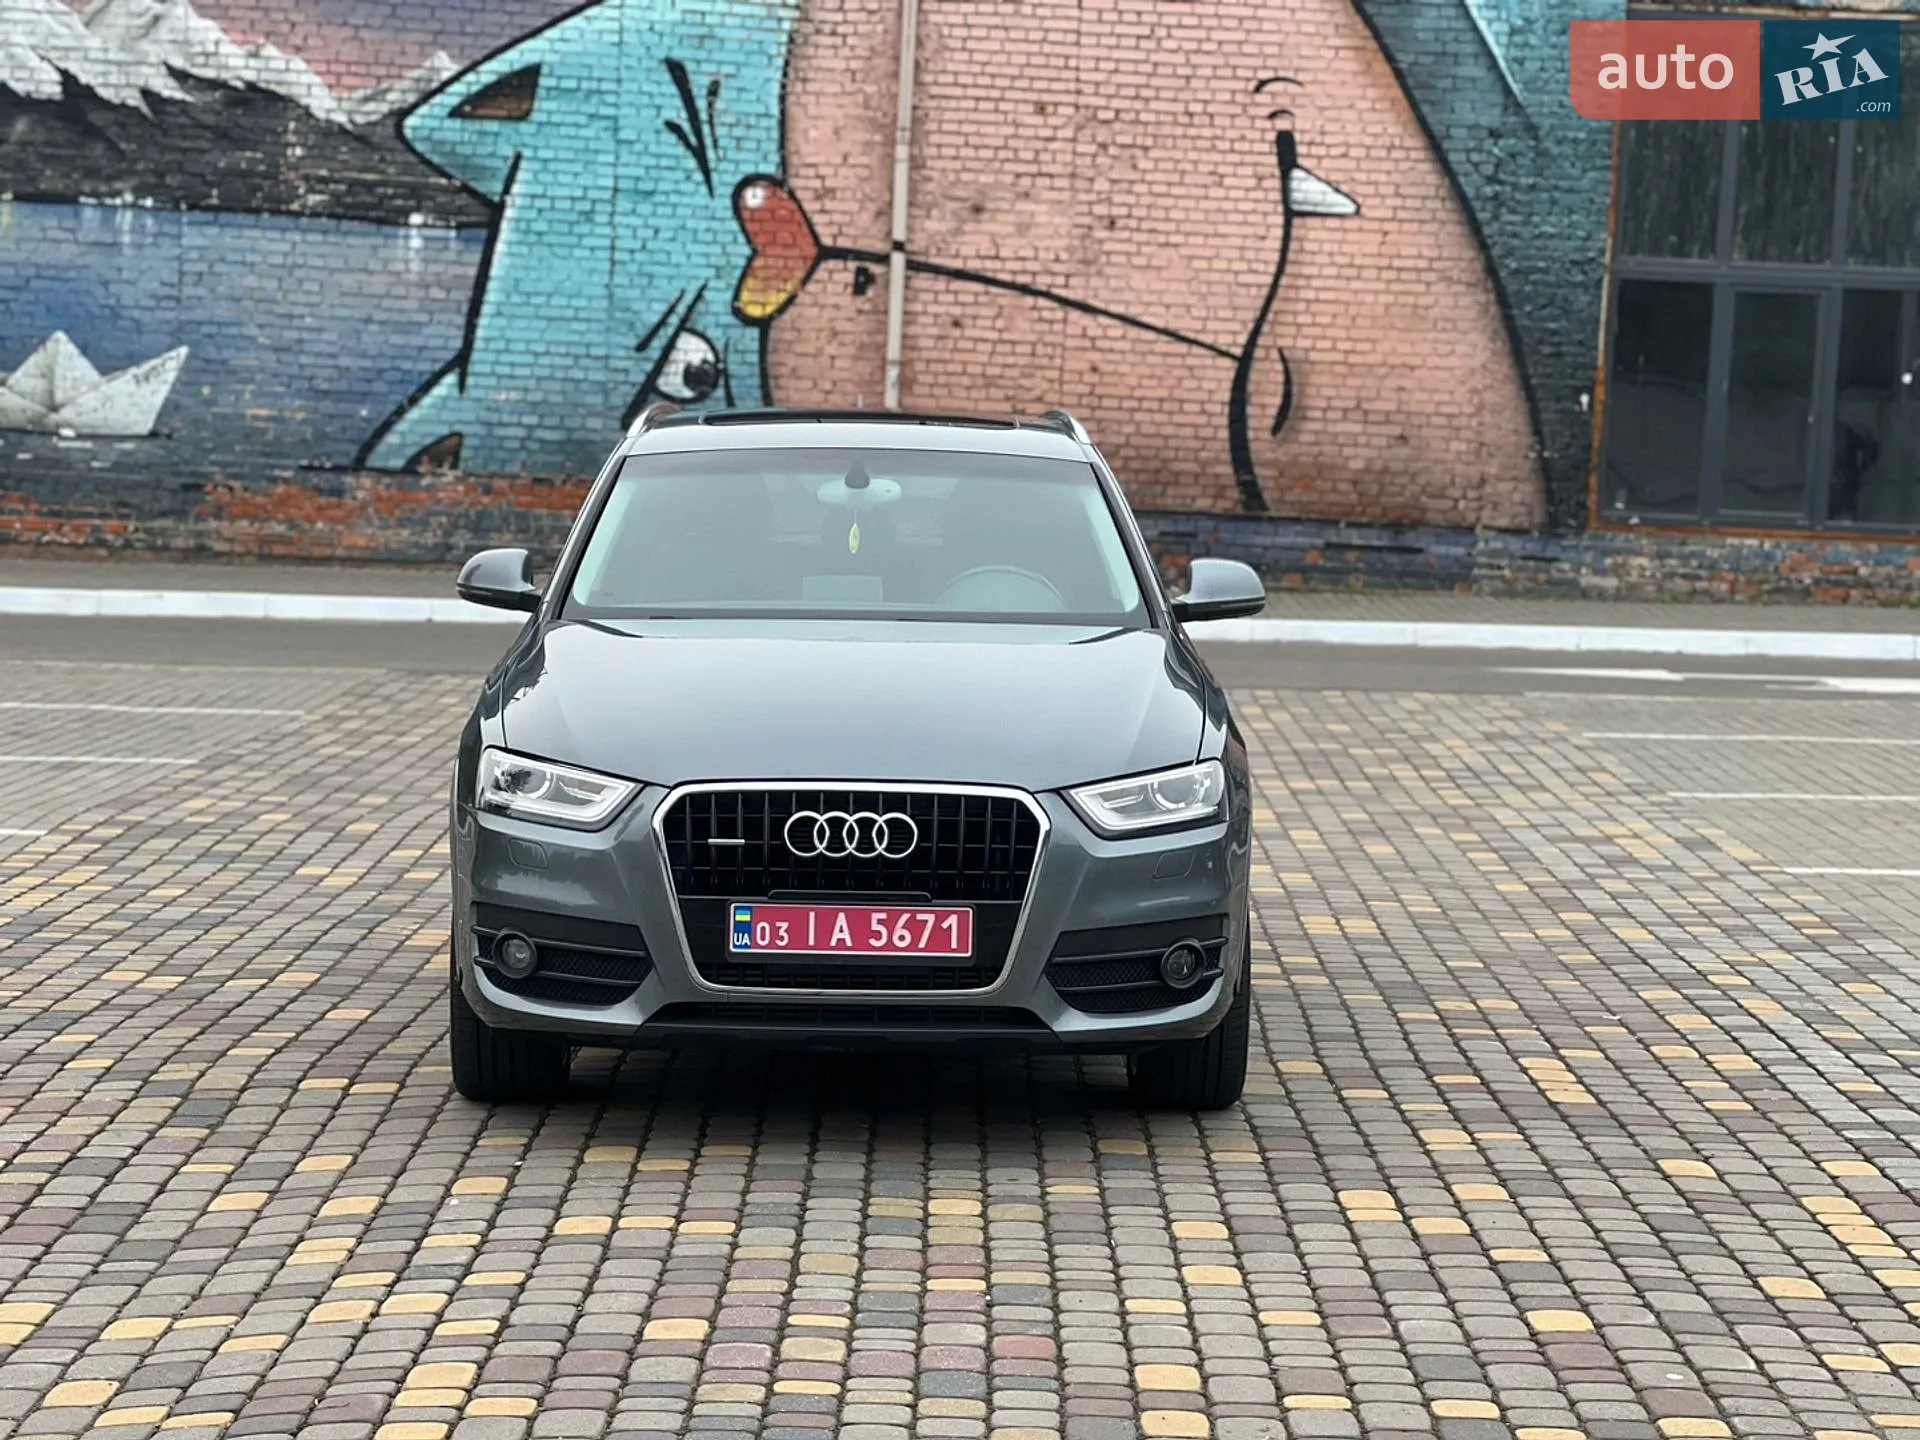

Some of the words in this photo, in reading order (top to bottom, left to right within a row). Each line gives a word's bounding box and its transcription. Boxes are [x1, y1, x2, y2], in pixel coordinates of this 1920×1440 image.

[733, 932, 751, 946] UA
[755, 921, 790, 947] 03
[807, 911, 853, 947] IA
[868, 911, 960, 950] 5671
